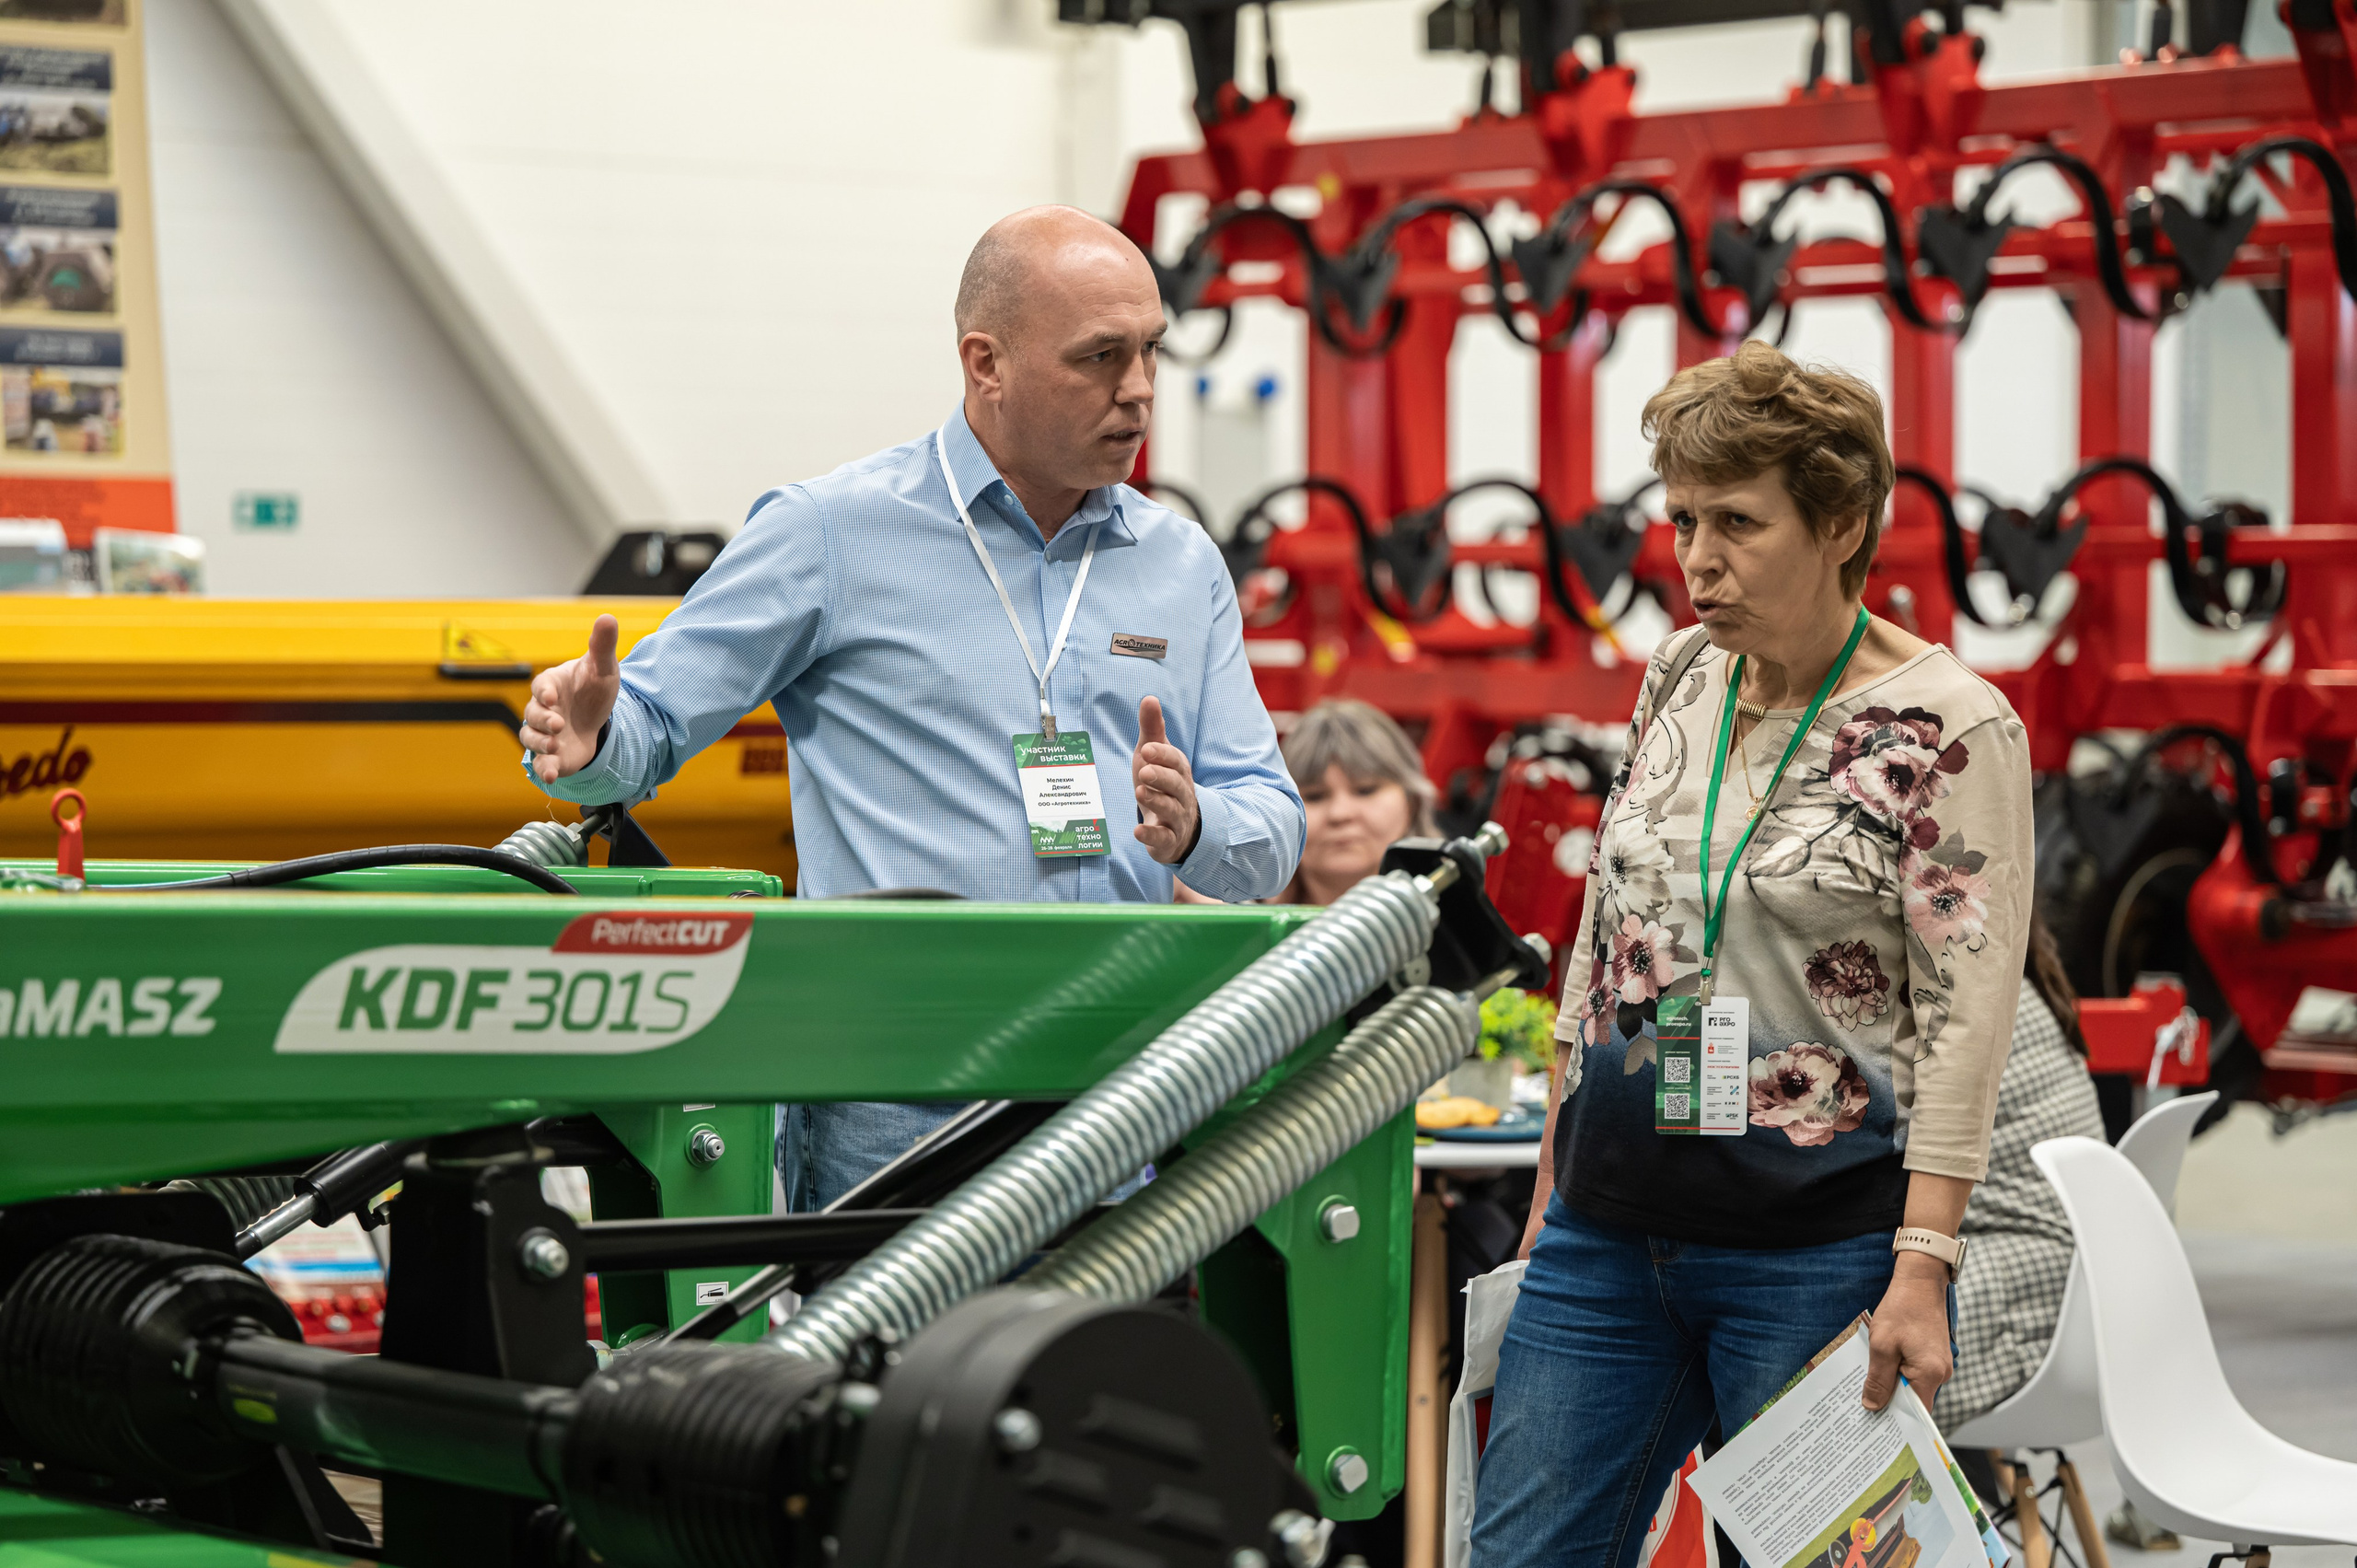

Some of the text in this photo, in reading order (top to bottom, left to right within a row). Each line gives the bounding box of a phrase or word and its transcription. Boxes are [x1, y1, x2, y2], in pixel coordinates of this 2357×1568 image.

[1020, 745, 1066, 756] участник
[1039, 753, 1086, 762] выставки
[1074, 826, 1095, 834] агро
[591, 917, 731, 947] PerfectCUT
